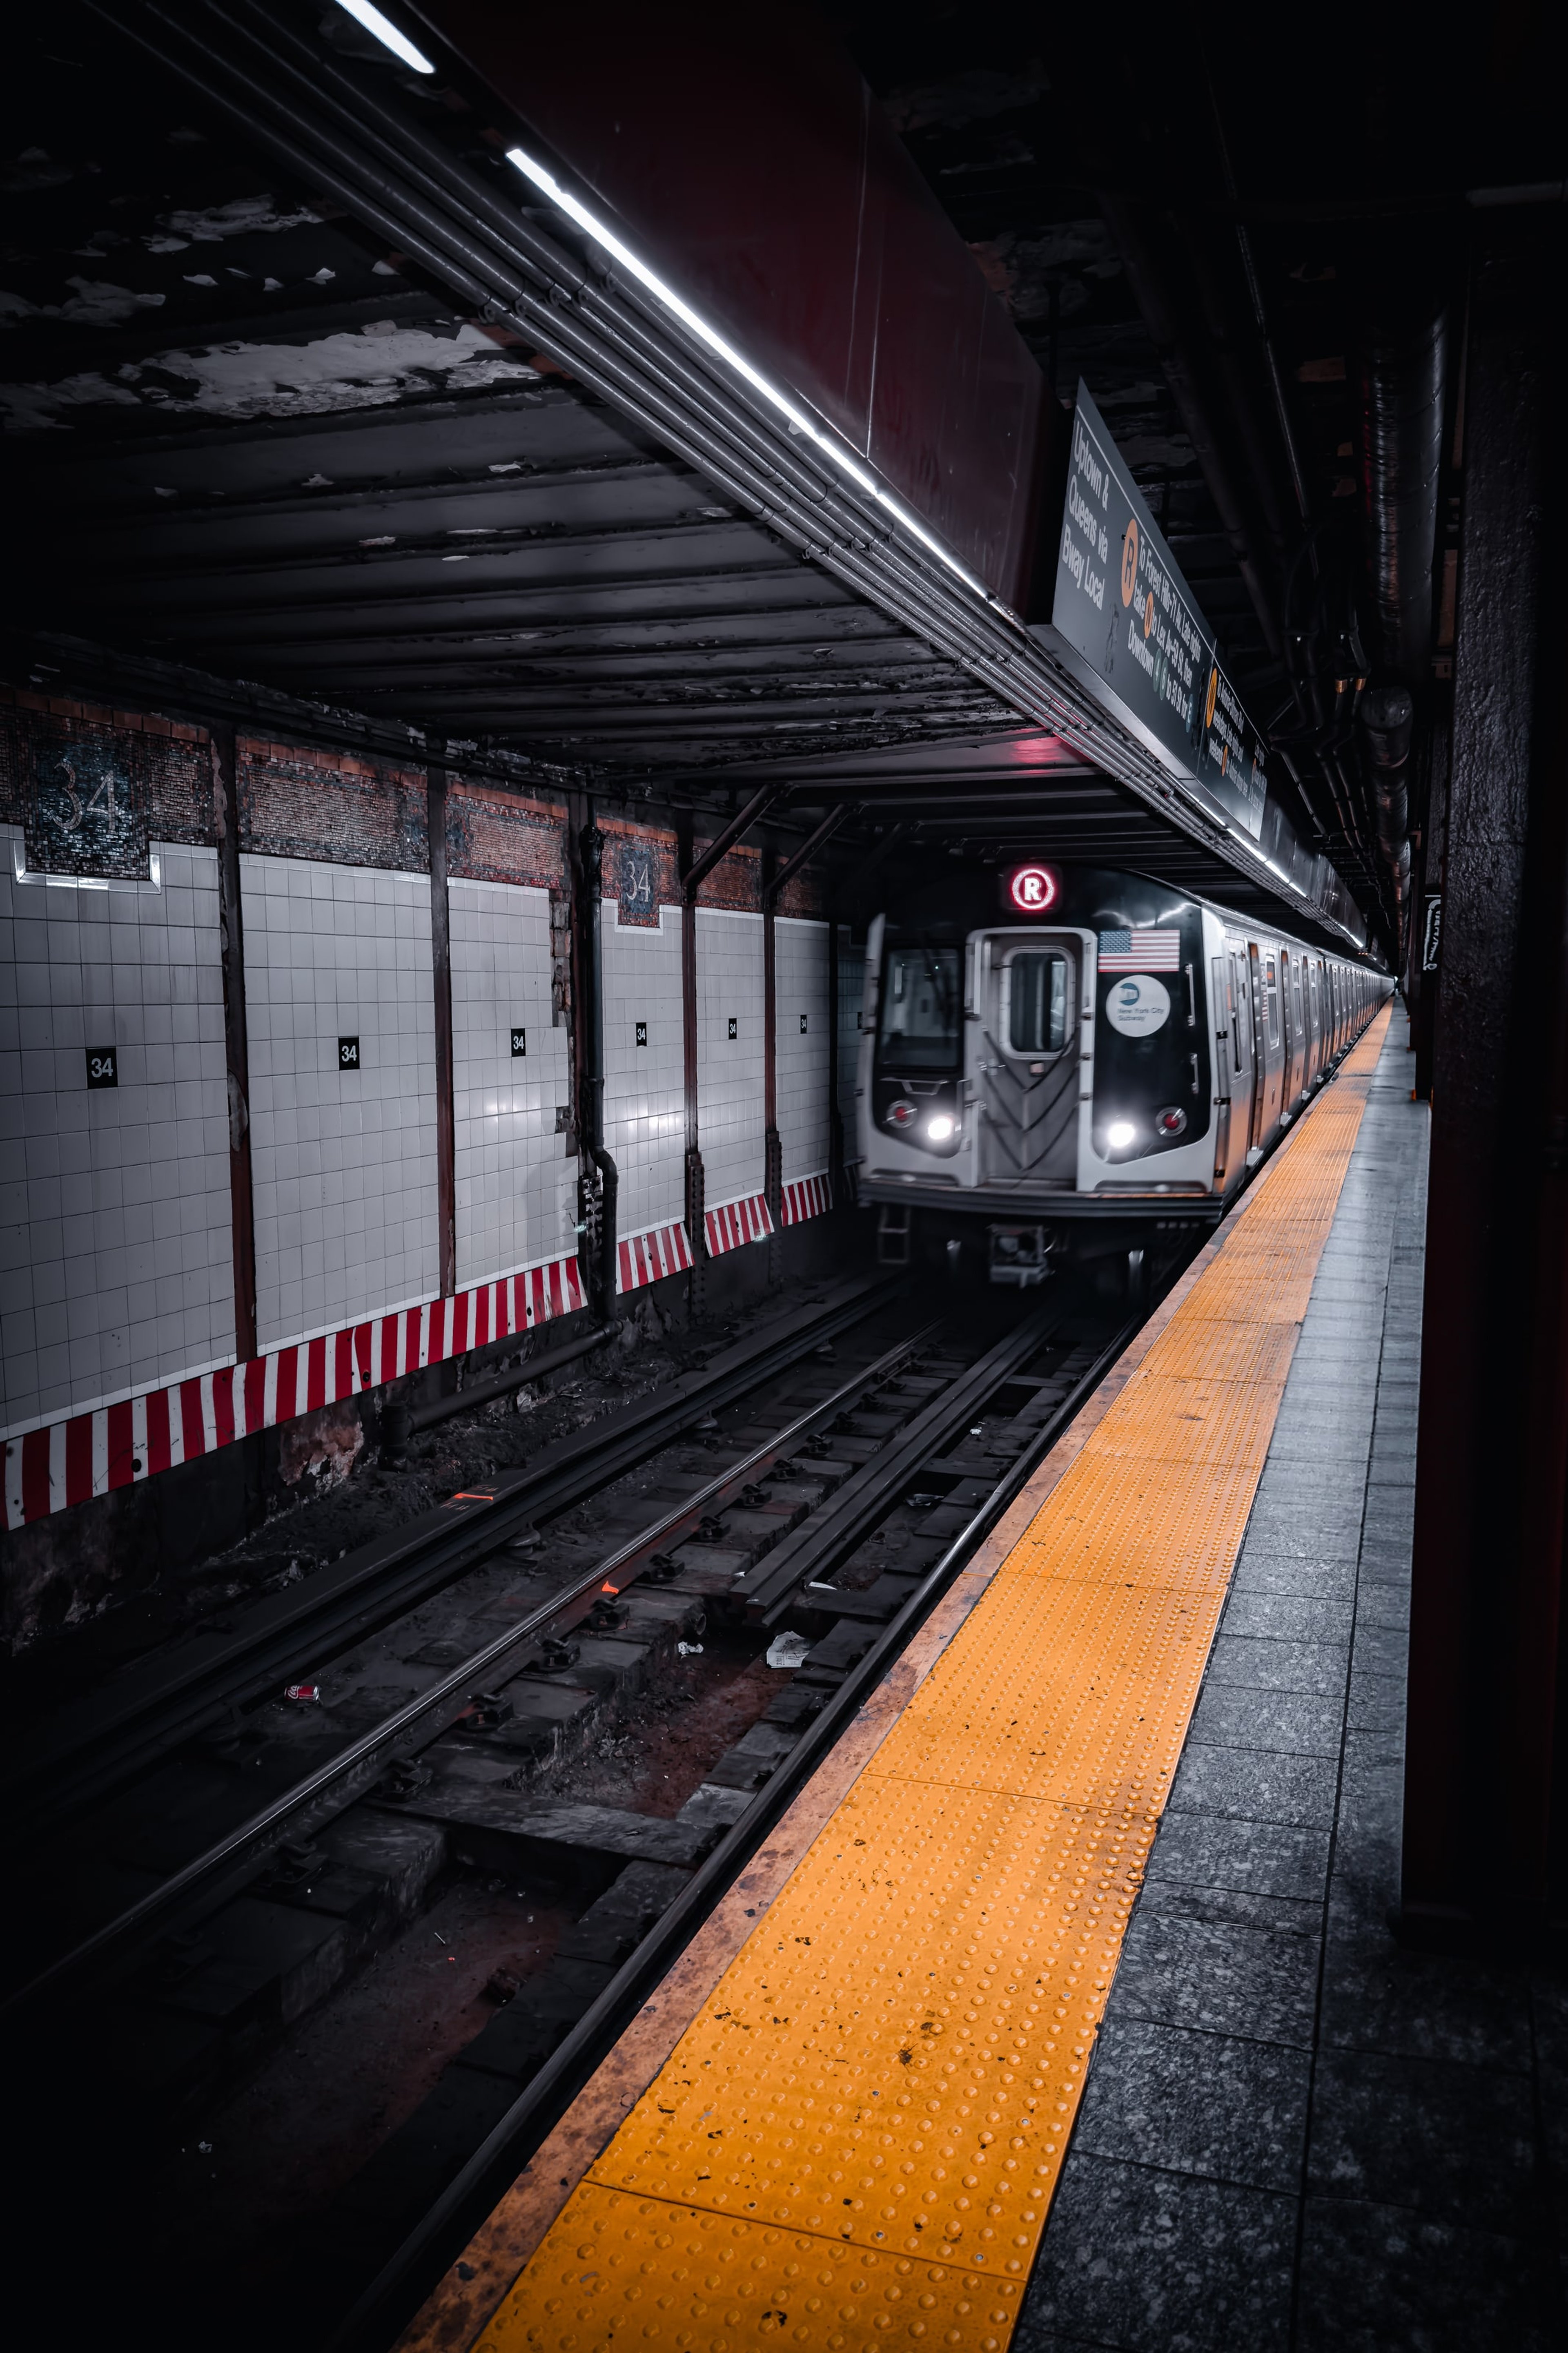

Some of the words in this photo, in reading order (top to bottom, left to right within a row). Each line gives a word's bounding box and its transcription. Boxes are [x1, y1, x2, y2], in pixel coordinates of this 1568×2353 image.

[1074, 420, 1102, 499] Uptown
[1102, 474, 1109, 512] &
[1069, 475, 1097, 546] Queens
[1098, 525, 1107, 564] via
[1062, 524, 1084, 589] Bway
[1084, 555, 1105, 610] Local
[1124, 537, 1134, 589] R
[1139, 535, 1145, 571] To
[1145, 549, 1162, 598] Forest
[1181, 612, 1191, 647] Late
[1189, 630, 1201, 663] nights
[1128, 619, 1154, 677] Downtown
[1166, 674, 1172, 700] to
[1134, 579, 1145, 620] take
[1152, 607, 1156, 637] to
[1156, 614, 1166, 650] Lex
[1184, 658, 1192, 689] then
[47, 762, 118, 834] 34
[626, 861, 650, 902] 34
[1025, 878, 1041, 901] R
[342, 1045, 357, 1062] 34
[513, 1035, 524, 1049] 34
[637, 1028, 646, 1040] 34
[730, 1024, 736, 1034] 34
[91, 1058, 113, 1077] 34
